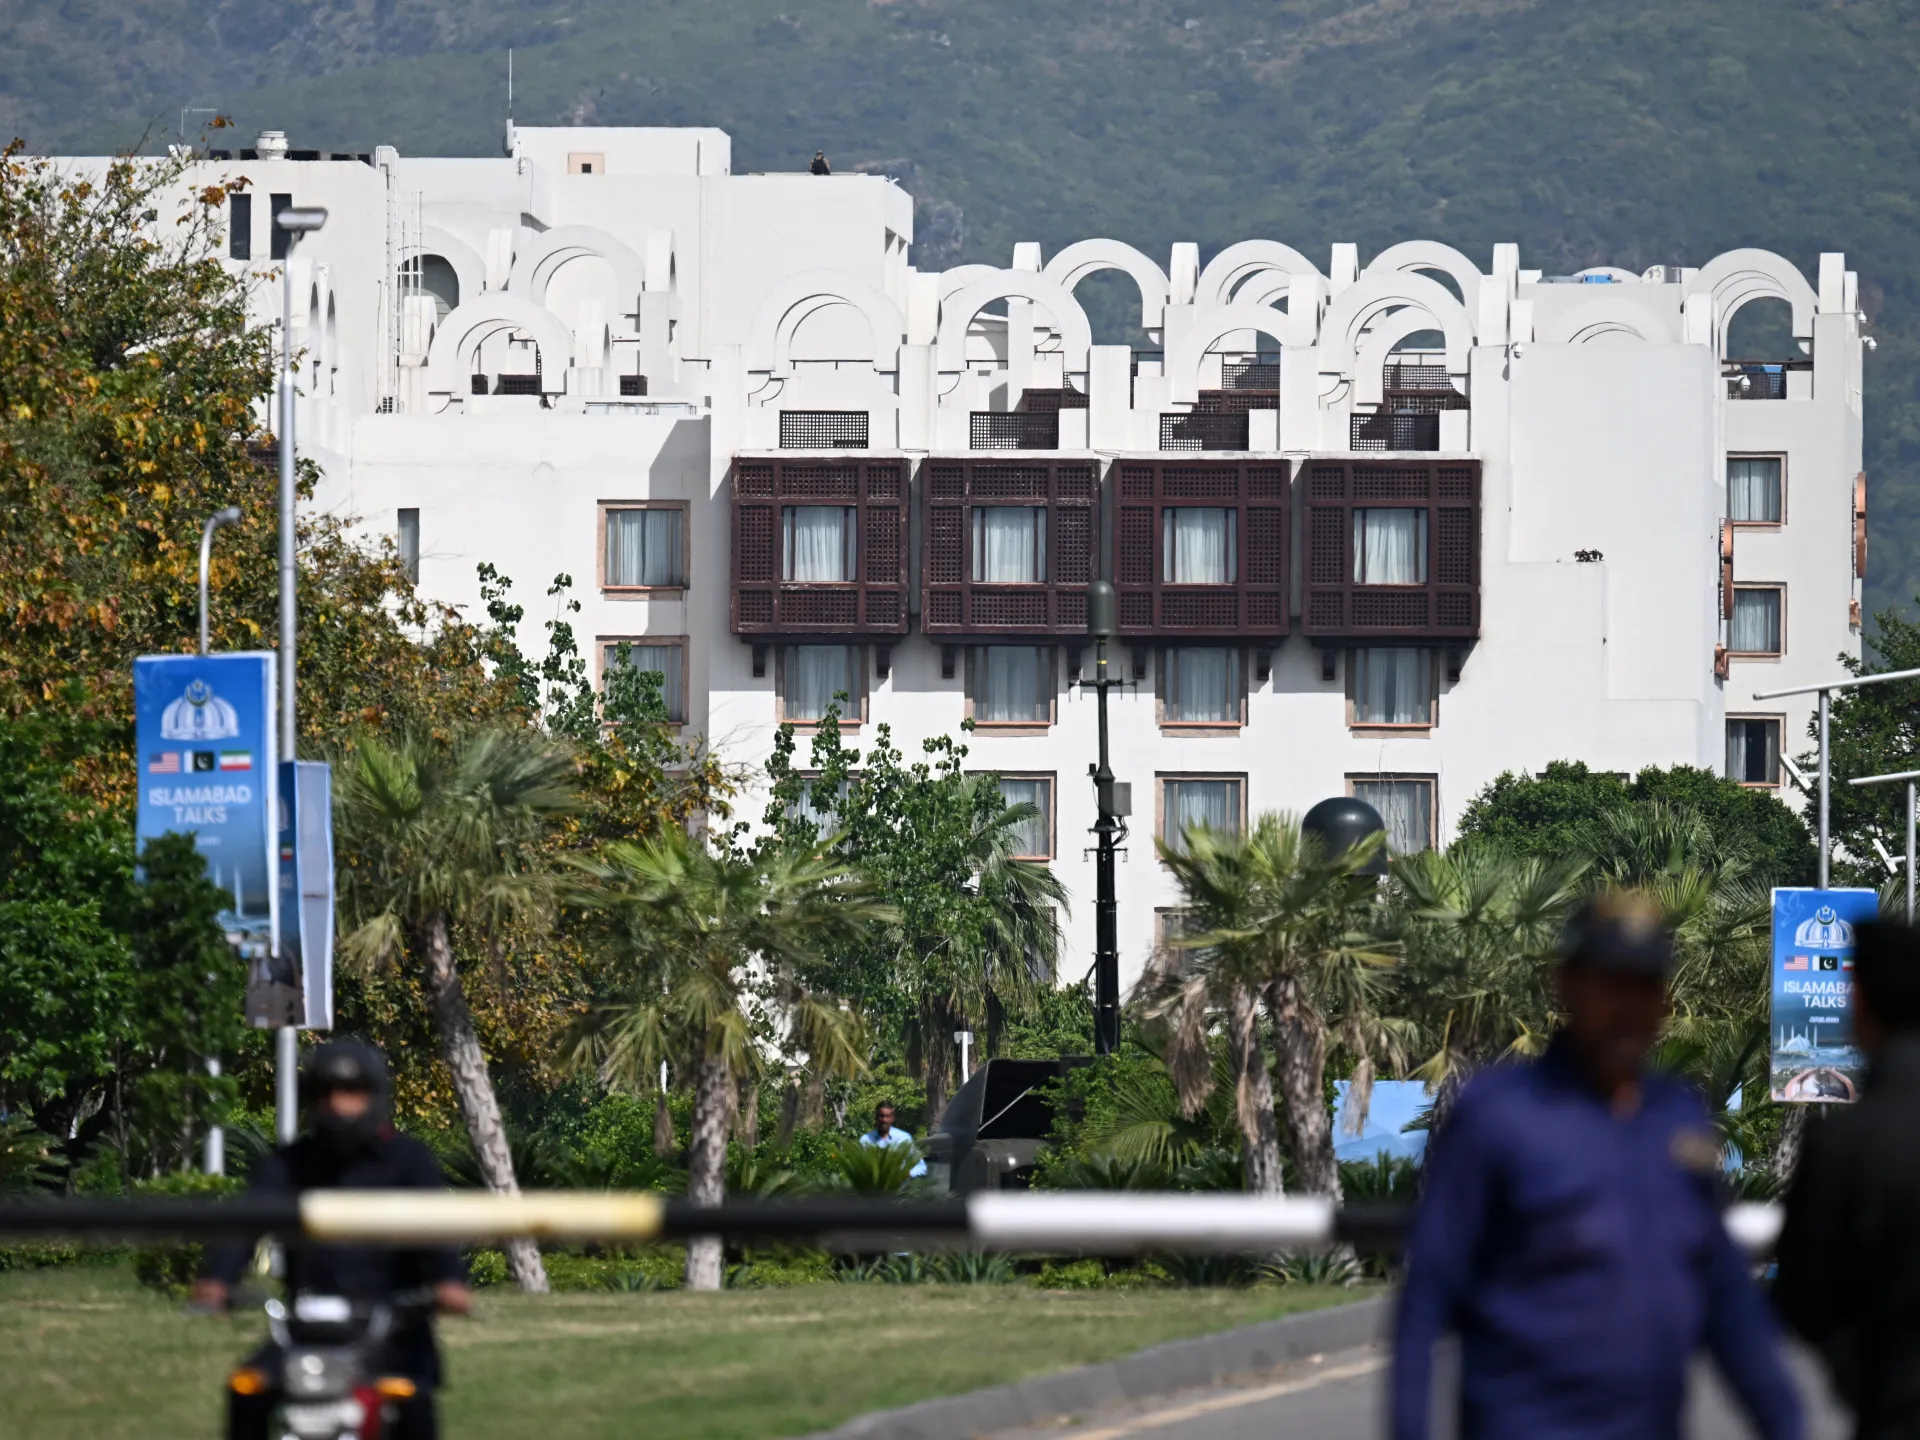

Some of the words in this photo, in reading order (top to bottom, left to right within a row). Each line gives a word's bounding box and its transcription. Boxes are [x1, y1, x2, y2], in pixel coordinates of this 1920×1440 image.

[149, 785, 252, 806] ISLAMABAD
[174, 806, 227, 824] TALKS
[1784, 981, 1856, 994] ISLAMABA
[1803, 995, 1846, 1008] TALKS
